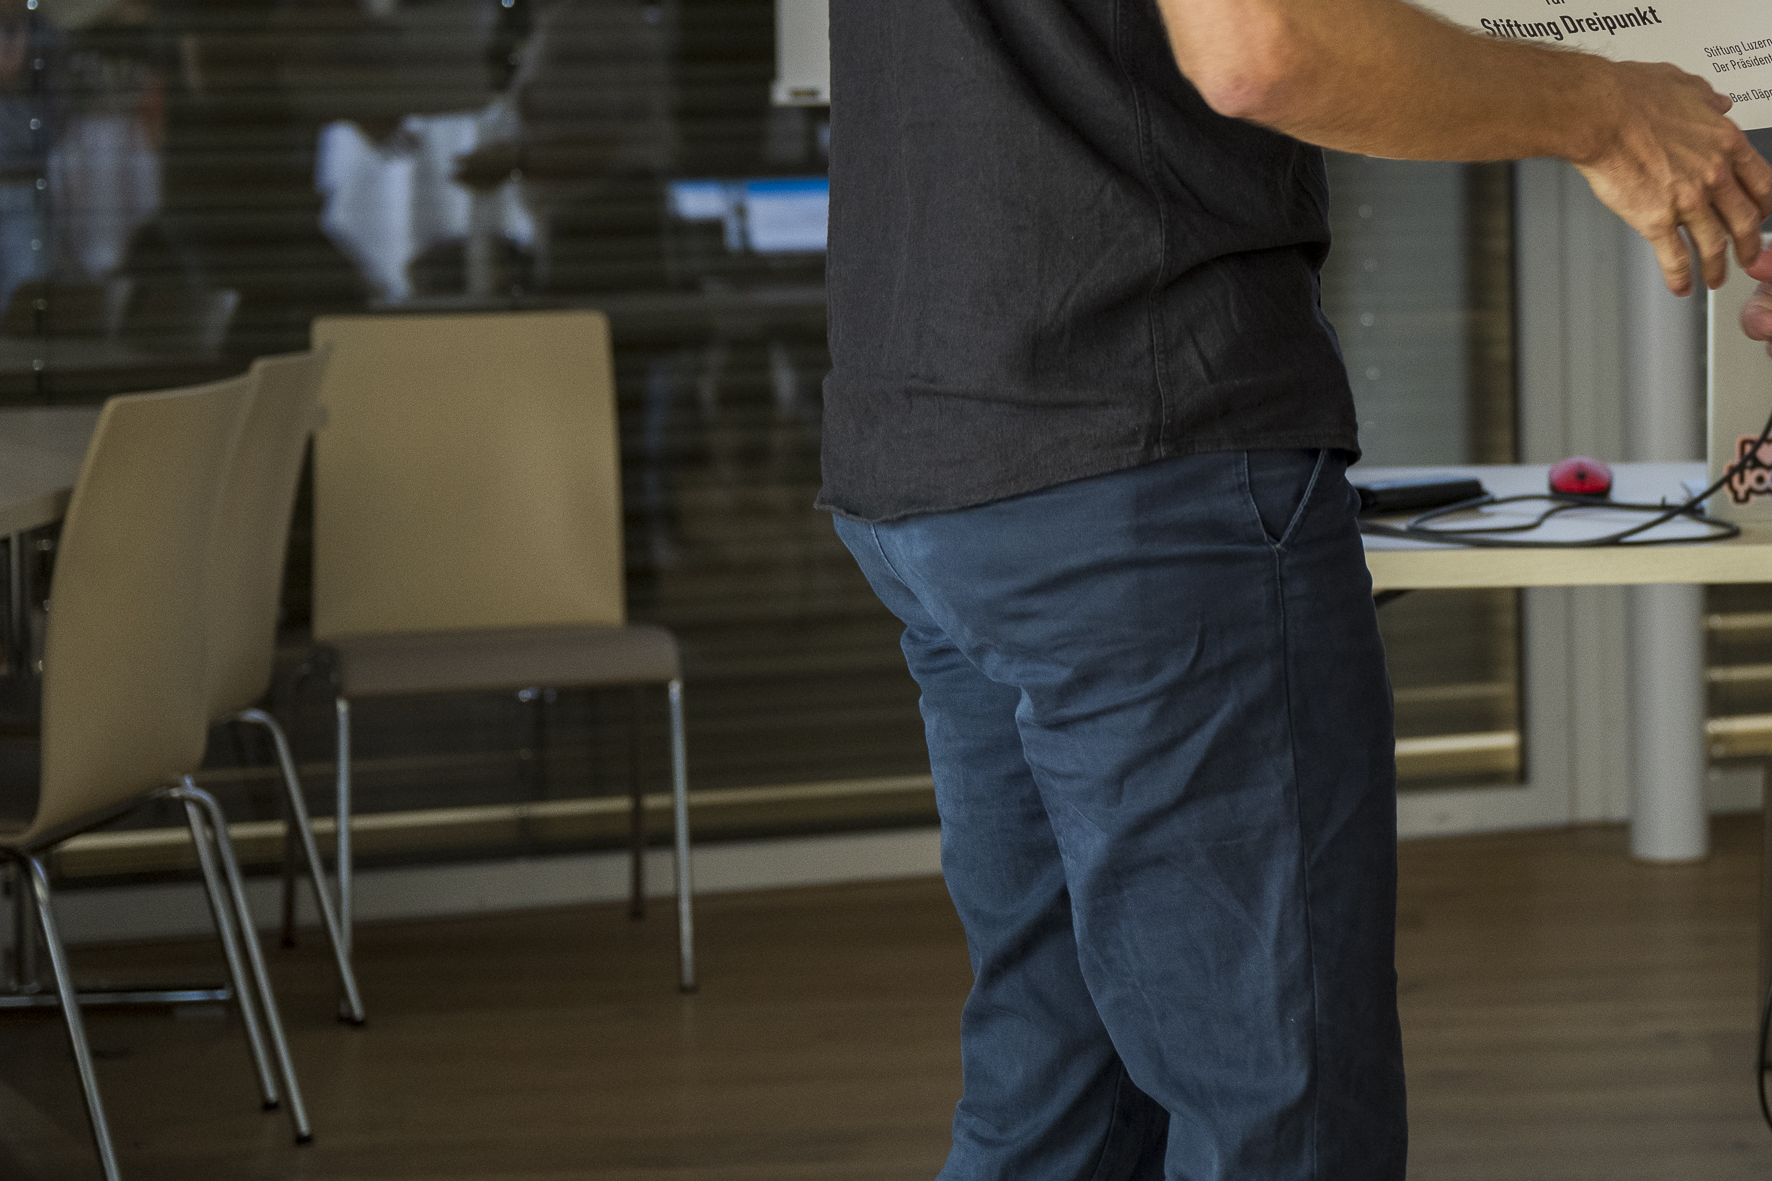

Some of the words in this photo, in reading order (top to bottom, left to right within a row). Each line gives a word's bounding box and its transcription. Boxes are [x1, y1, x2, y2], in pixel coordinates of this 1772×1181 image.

[1480, 17, 1564, 42] Stiftung
[1559, 5, 1663, 36] Dreipunkt
[1703, 45, 1743, 58] Stiftung
[1712, 61, 1730, 73] Der
[1729, 90, 1753, 104] Beat
